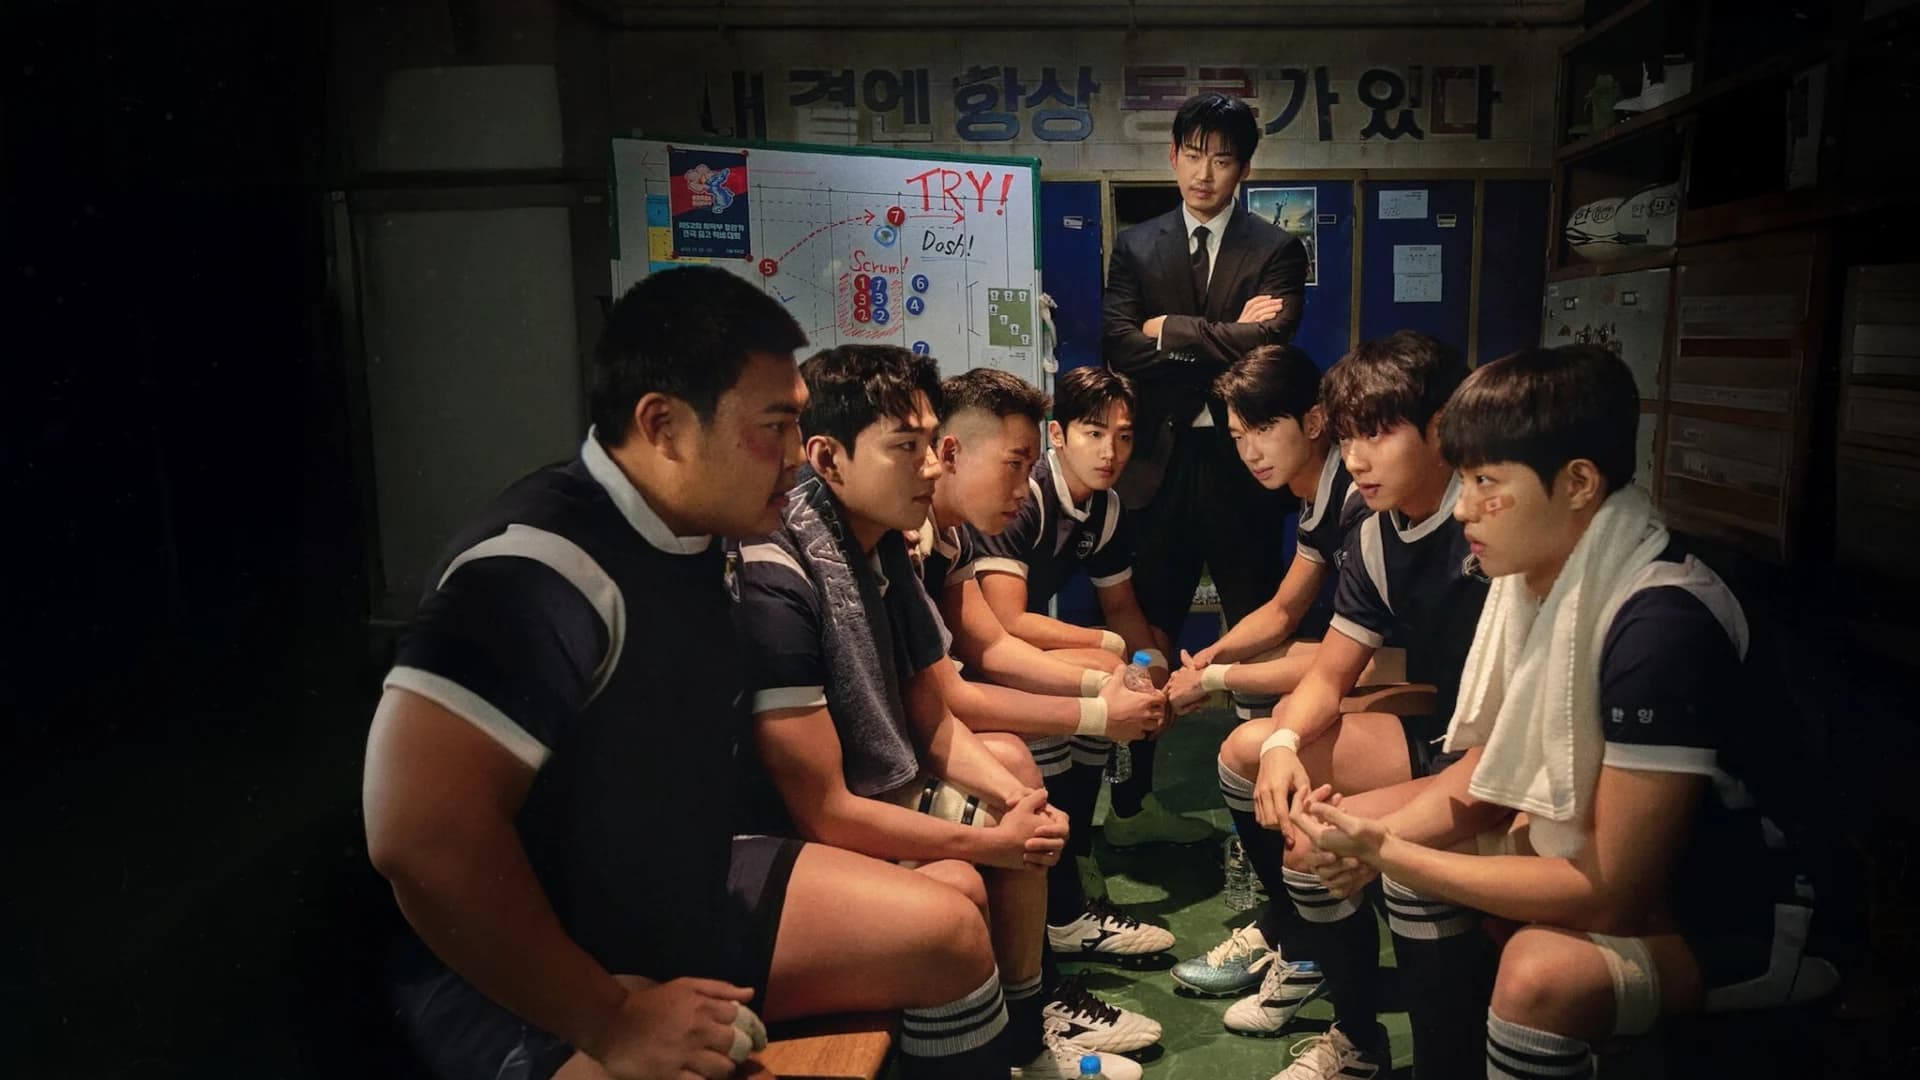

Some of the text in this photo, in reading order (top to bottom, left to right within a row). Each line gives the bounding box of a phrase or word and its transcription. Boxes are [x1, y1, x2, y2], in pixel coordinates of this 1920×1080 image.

[953, 65, 1100, 142] 항상
[1358, 64, 1503, 140] 있다
[906, 168, 1013, 216] TRY!
[850, 250, 908, 274] Scrum!
